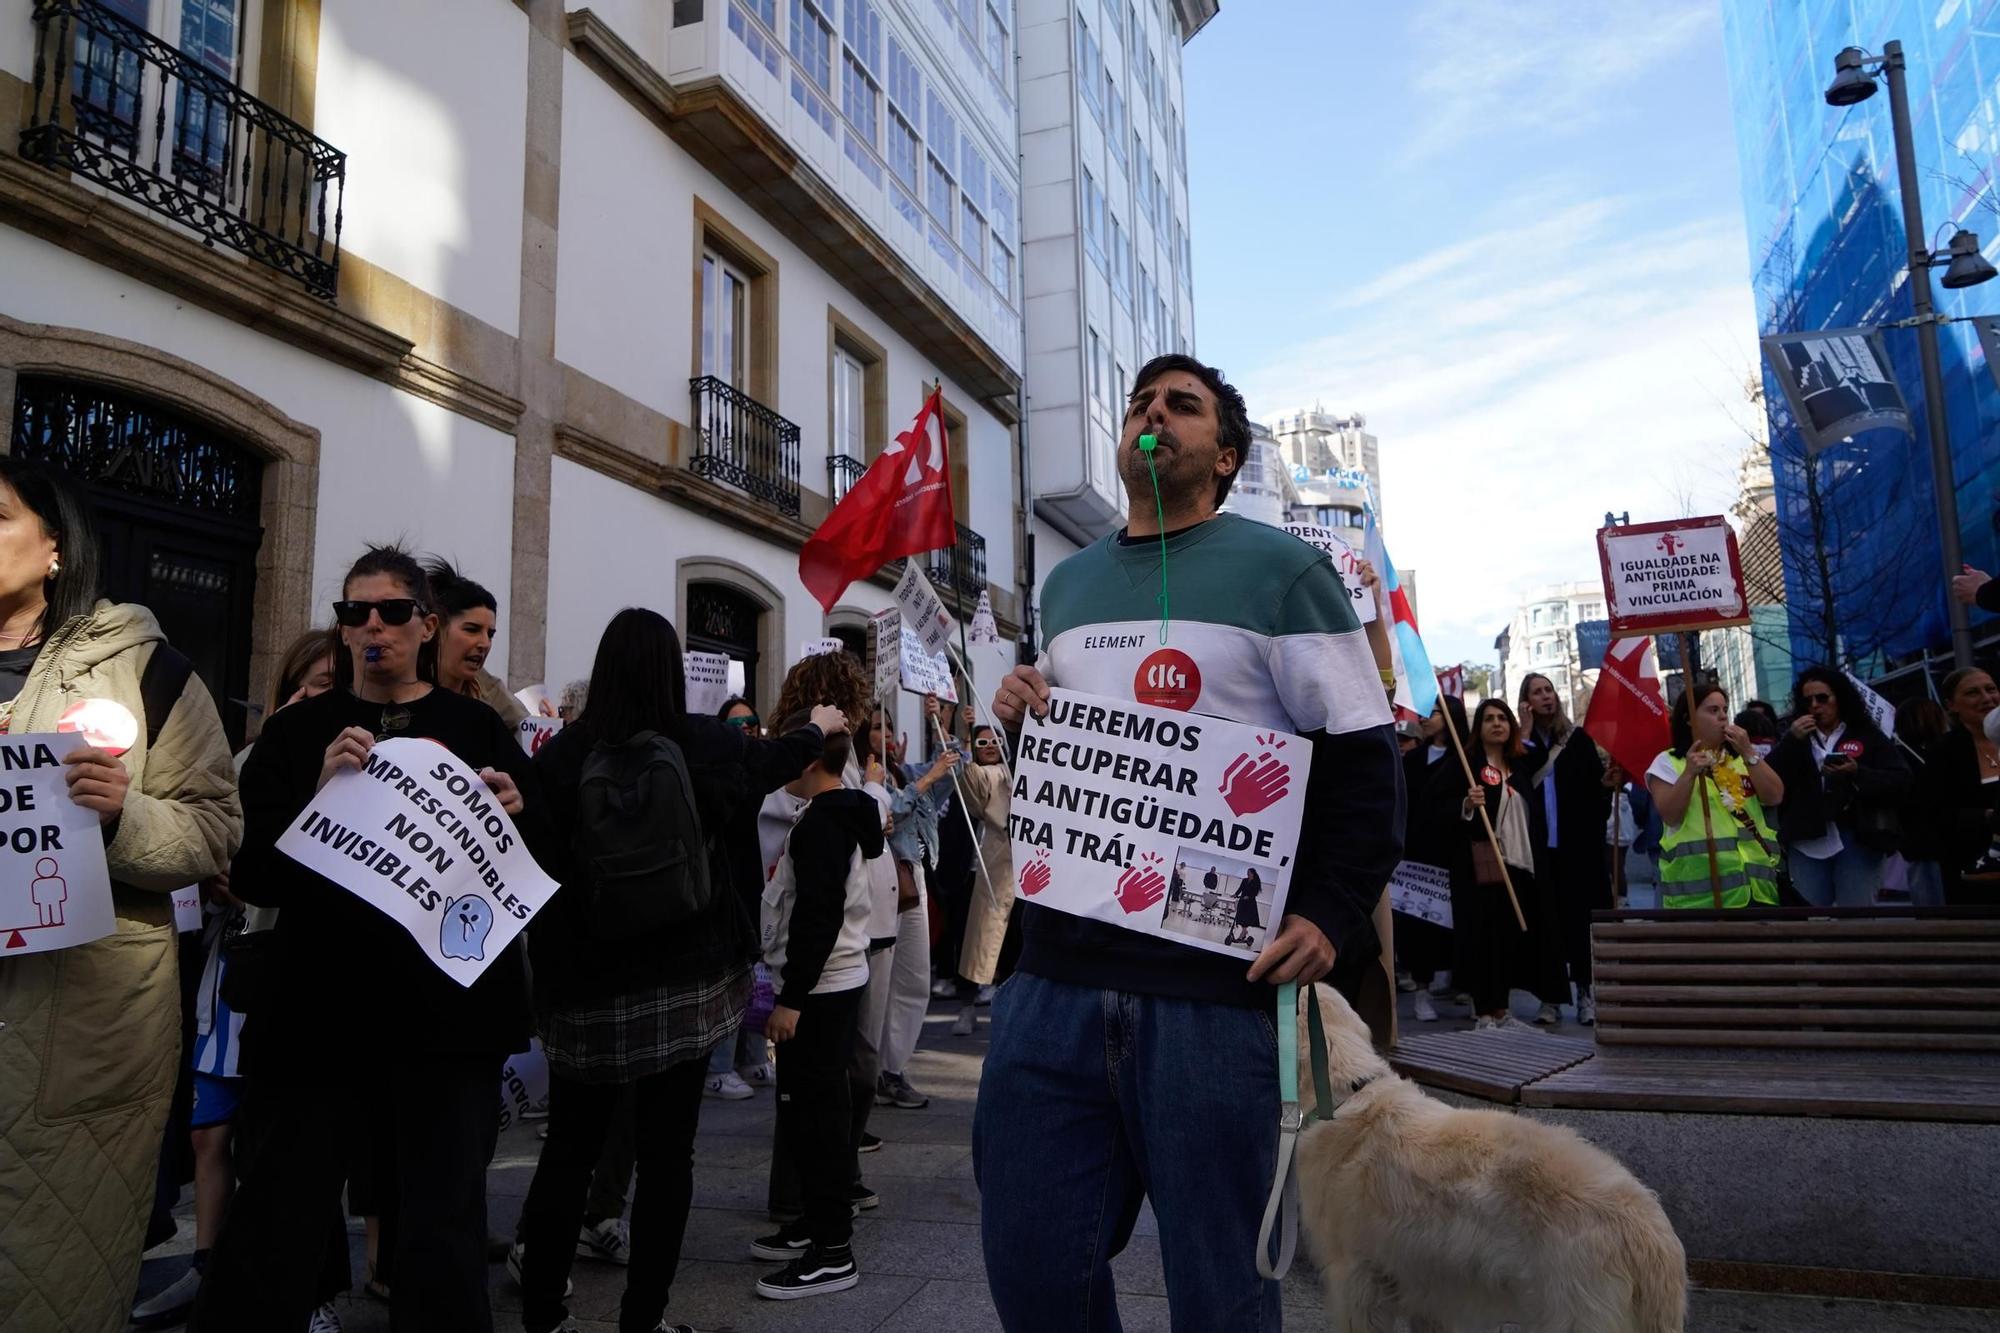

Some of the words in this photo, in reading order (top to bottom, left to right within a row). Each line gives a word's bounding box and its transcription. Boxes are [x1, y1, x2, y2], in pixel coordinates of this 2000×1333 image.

[1620, 555, 1697, 572] IGUALDADE
[1700, 552, 1721, 564] NA
[1624, 565, 1720, 584] ANTIGÜIDADE:
[1652, 579, 1696, 593] PRIMA
[1628, 587, 1722, 607] VINCULACIÓN
[1084, 635, 1145, 649] ELEMENT
[1147, 664, 1186, 688] CIG
[1020, 734, 1199, 797] RECUPERAR
[1013, 775, 1028, 801] A
[429, 762, 514, 854] SOMOS
[361, 752, 532, 920] MPRESCINDIBLES
[384, 812, 454, 874] NON
[1010, 813, 1054, 850] TRA
[1065, 828, 1136, 869] TRÁ!
[300, 811, 443, 912] INVISIBLES
[1406, 864, 1436, 875] PRIMA
[1405, 882, 1451, 903] CONDICIÓ
